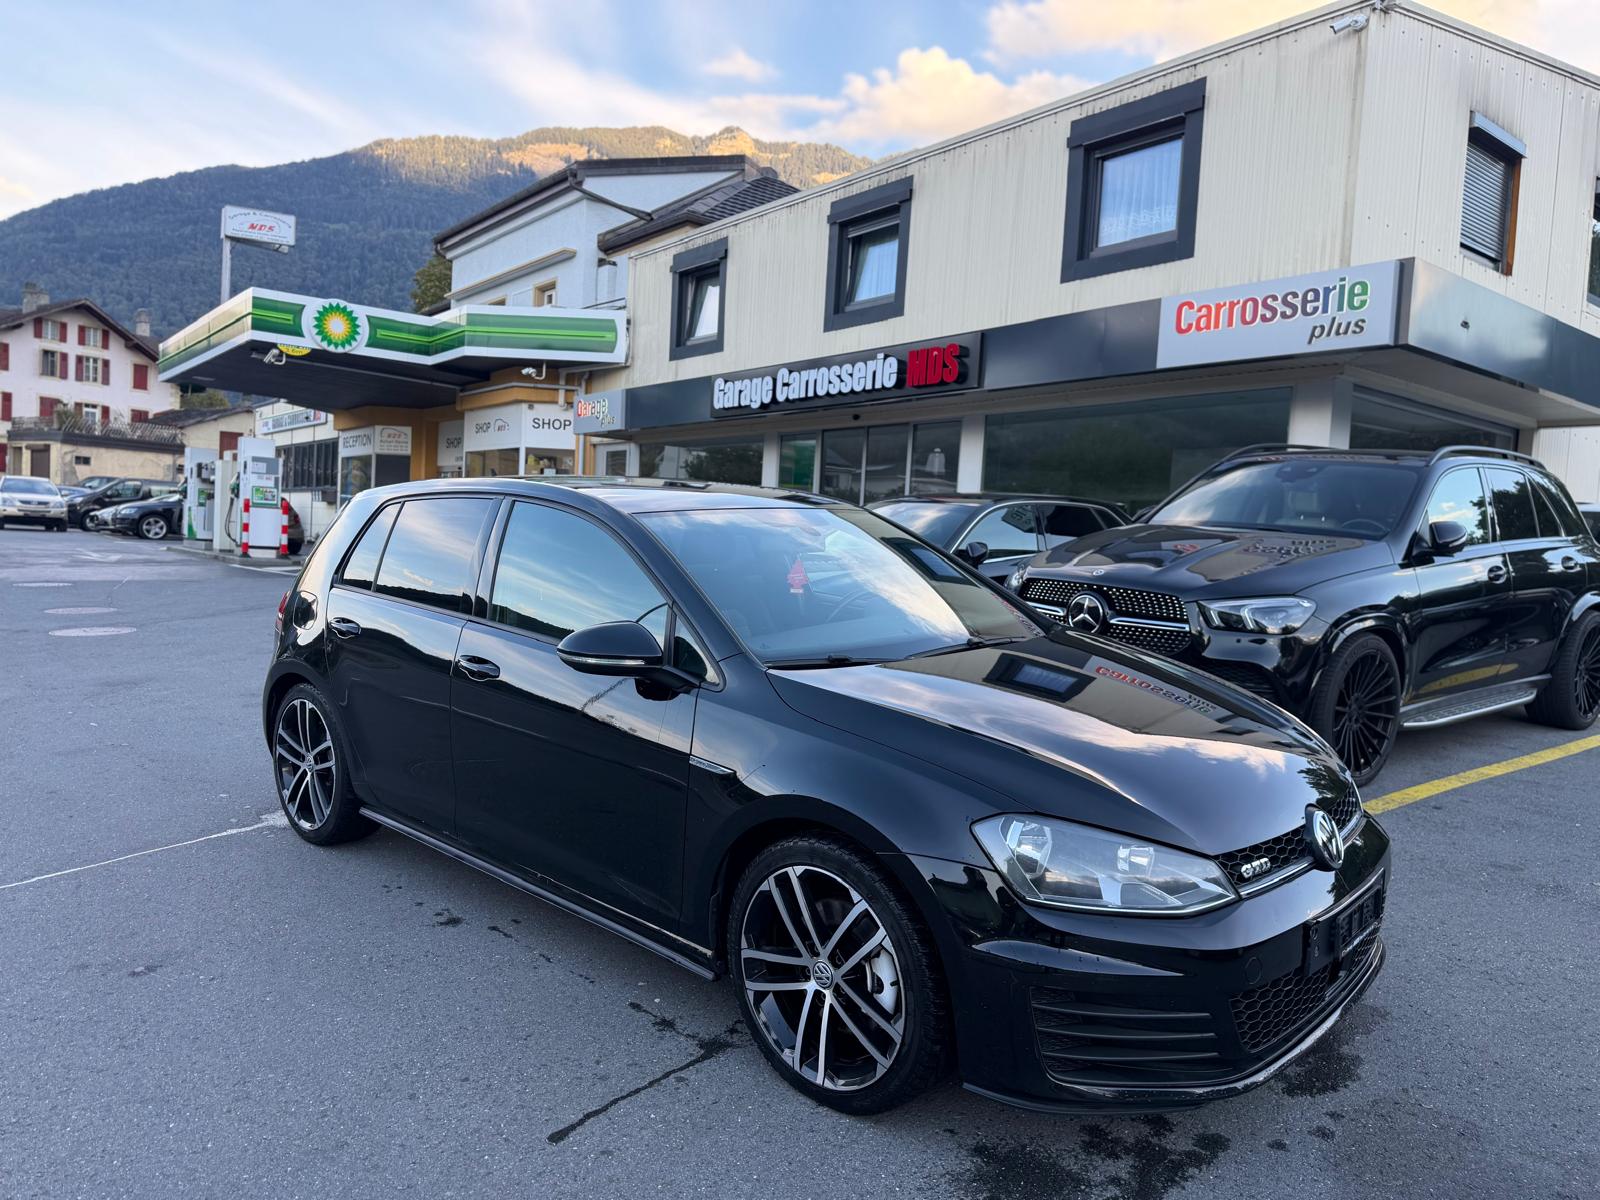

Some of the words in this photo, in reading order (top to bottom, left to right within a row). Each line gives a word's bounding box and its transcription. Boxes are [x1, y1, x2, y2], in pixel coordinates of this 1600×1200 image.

[1175, 276, 1370, 335] Carrosserie
[1307, 316, 1367, 344] plus
[713, 375, 773, 409] Garage
[775, 353, 898, 402] Carrosserie
[906, 343, 960, 387] MDS
[577, 399, 608, 420] Garage
[475, 422, 491, 434] SHOP
[532, 418, 572, 430] SHOP
[601, 414, 616, 428] plus
[343, 434, 372, 448] RECEPTION
[446, 438, 462, 449] SHOP
